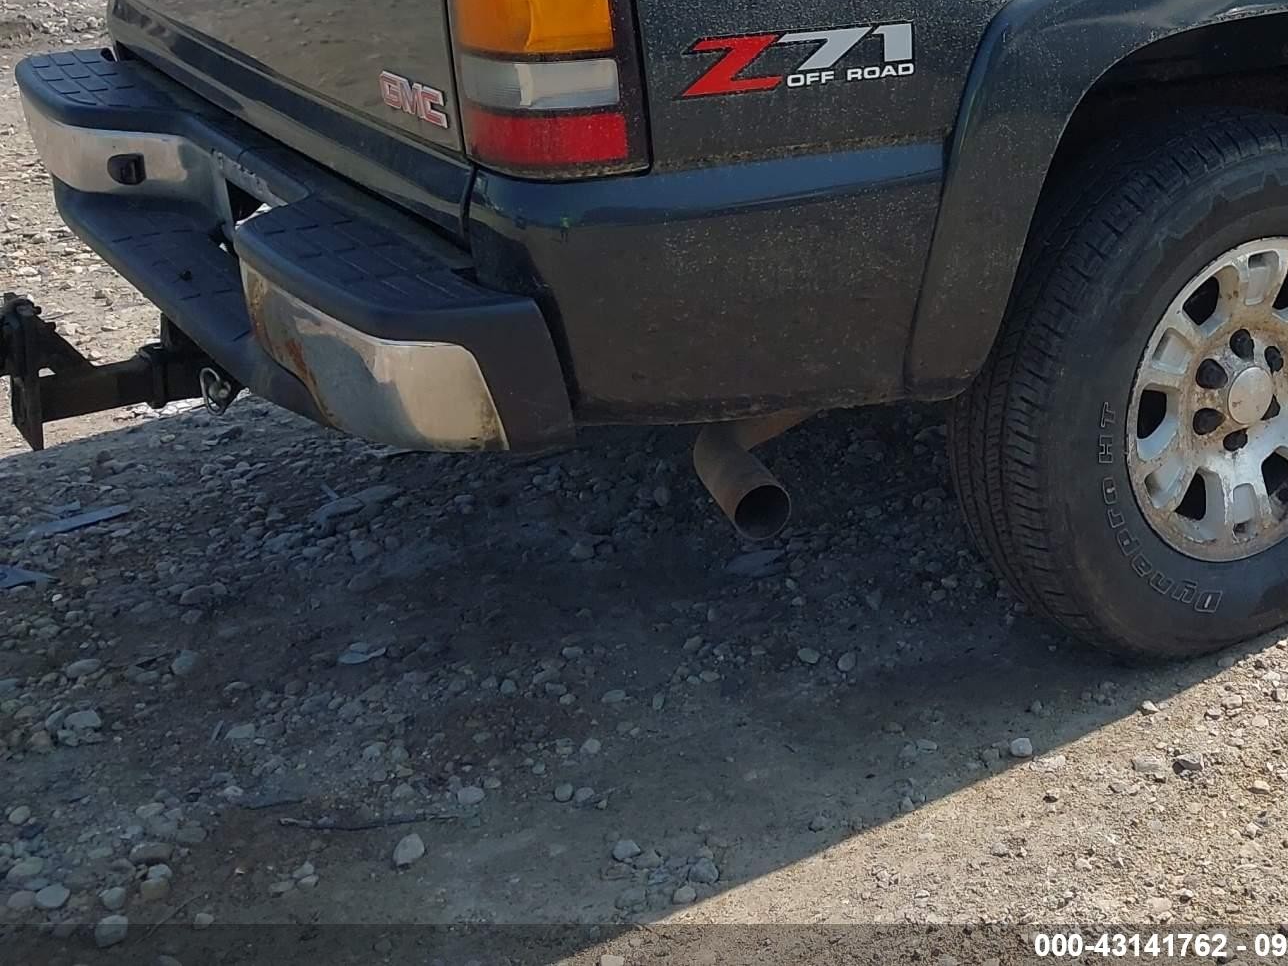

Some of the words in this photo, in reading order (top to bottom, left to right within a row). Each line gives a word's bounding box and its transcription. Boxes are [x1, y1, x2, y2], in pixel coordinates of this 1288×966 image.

[681, 22, 914, 98] Z71
[786, 70, 835, 88] OFF
[847, 63, 915, 82] ROAD
[378, 70, 449, 130] GMC
